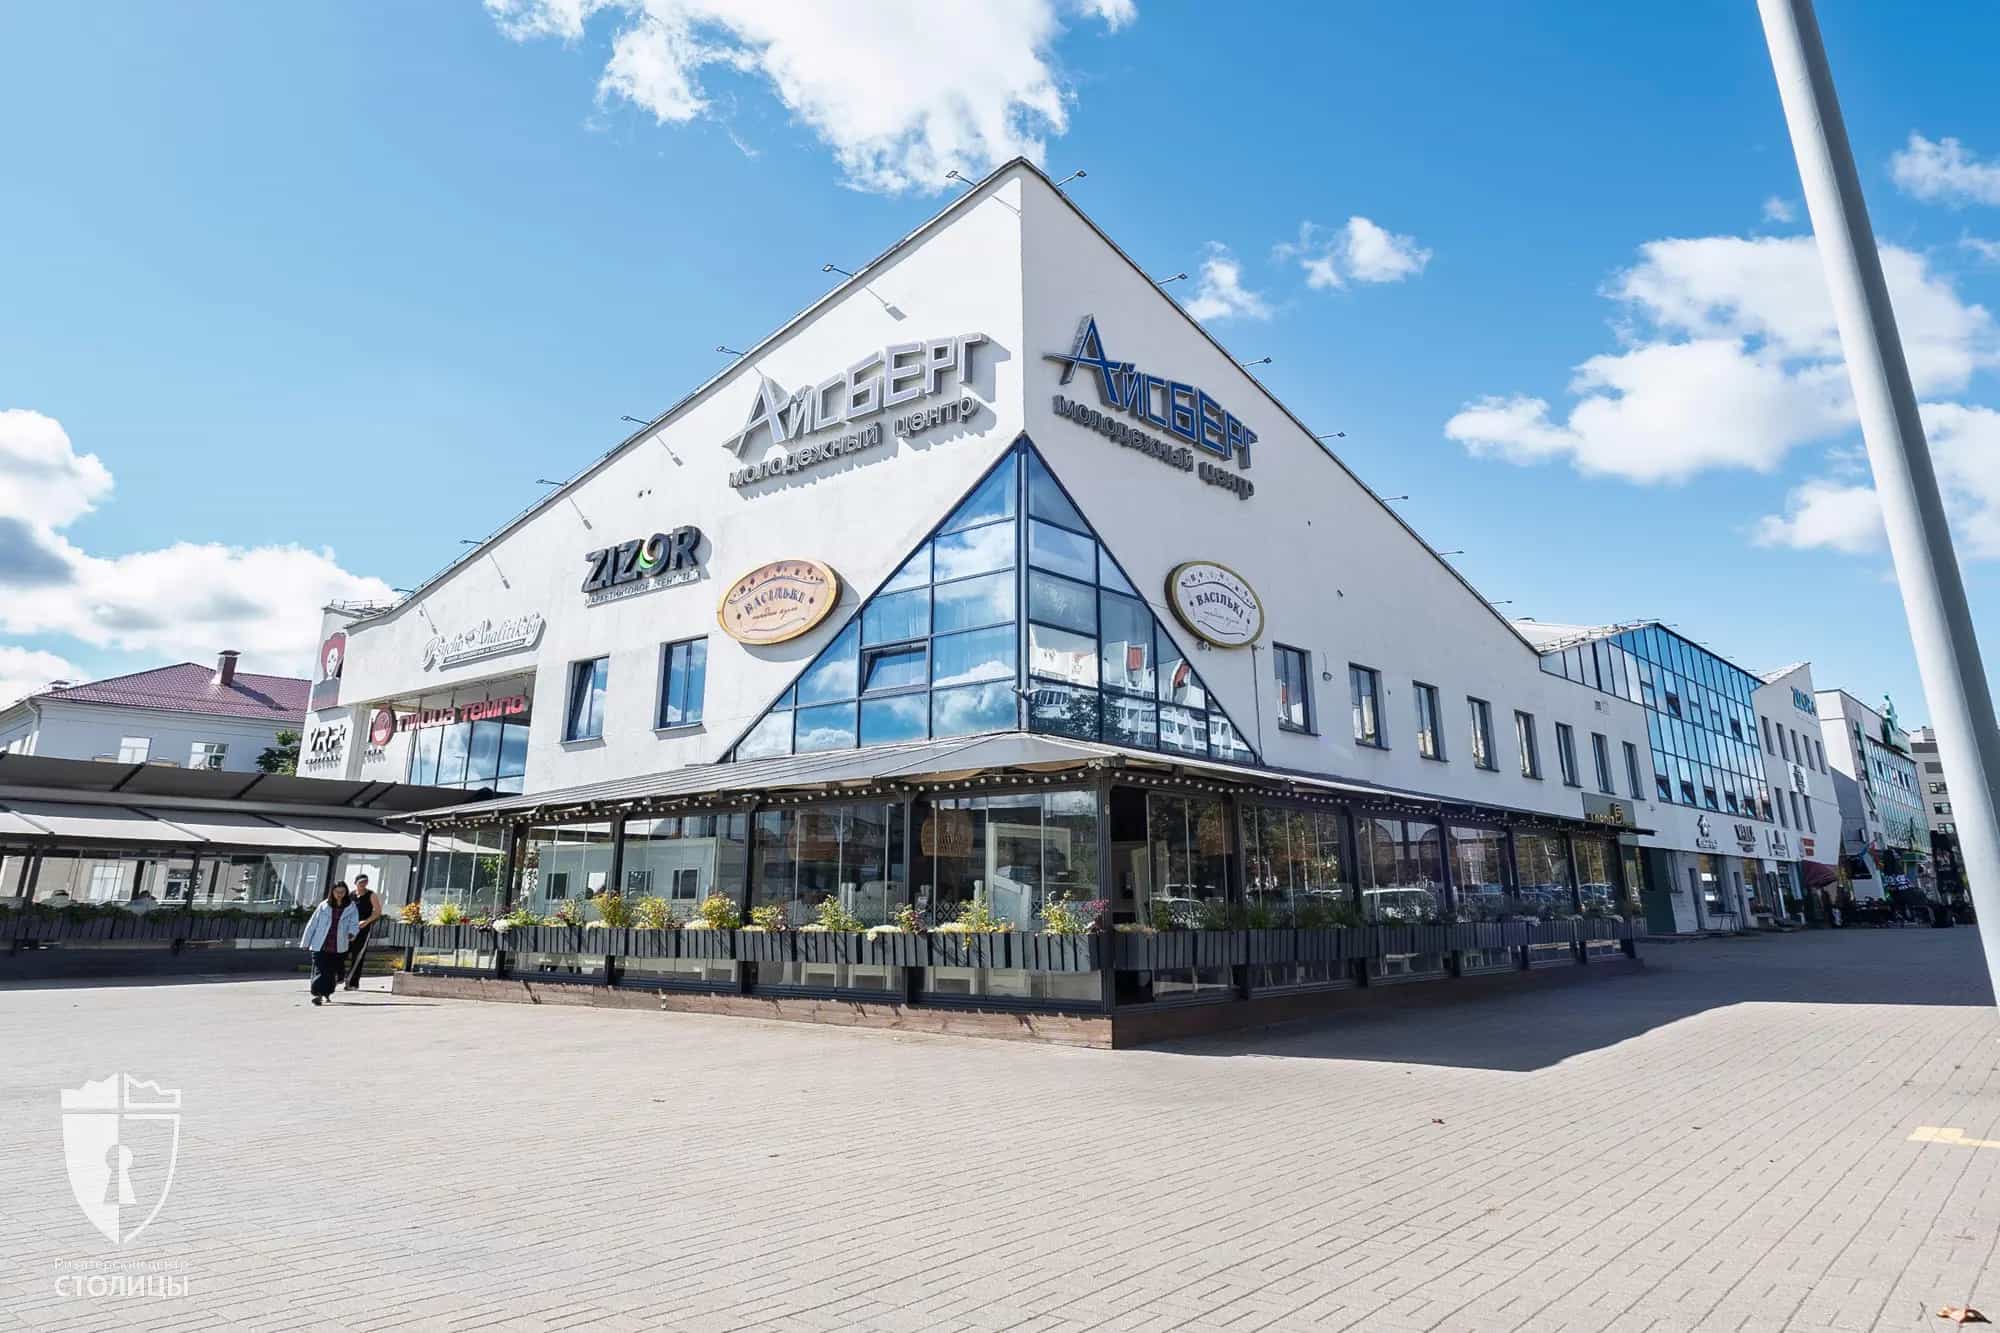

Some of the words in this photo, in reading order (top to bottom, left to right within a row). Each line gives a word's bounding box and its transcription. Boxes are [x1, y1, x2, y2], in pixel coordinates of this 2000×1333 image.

[729, 422, 883, 488] молодежный
[894, 397, 977, 438] центр
[582, 525, 704, 594] ZIZOR
